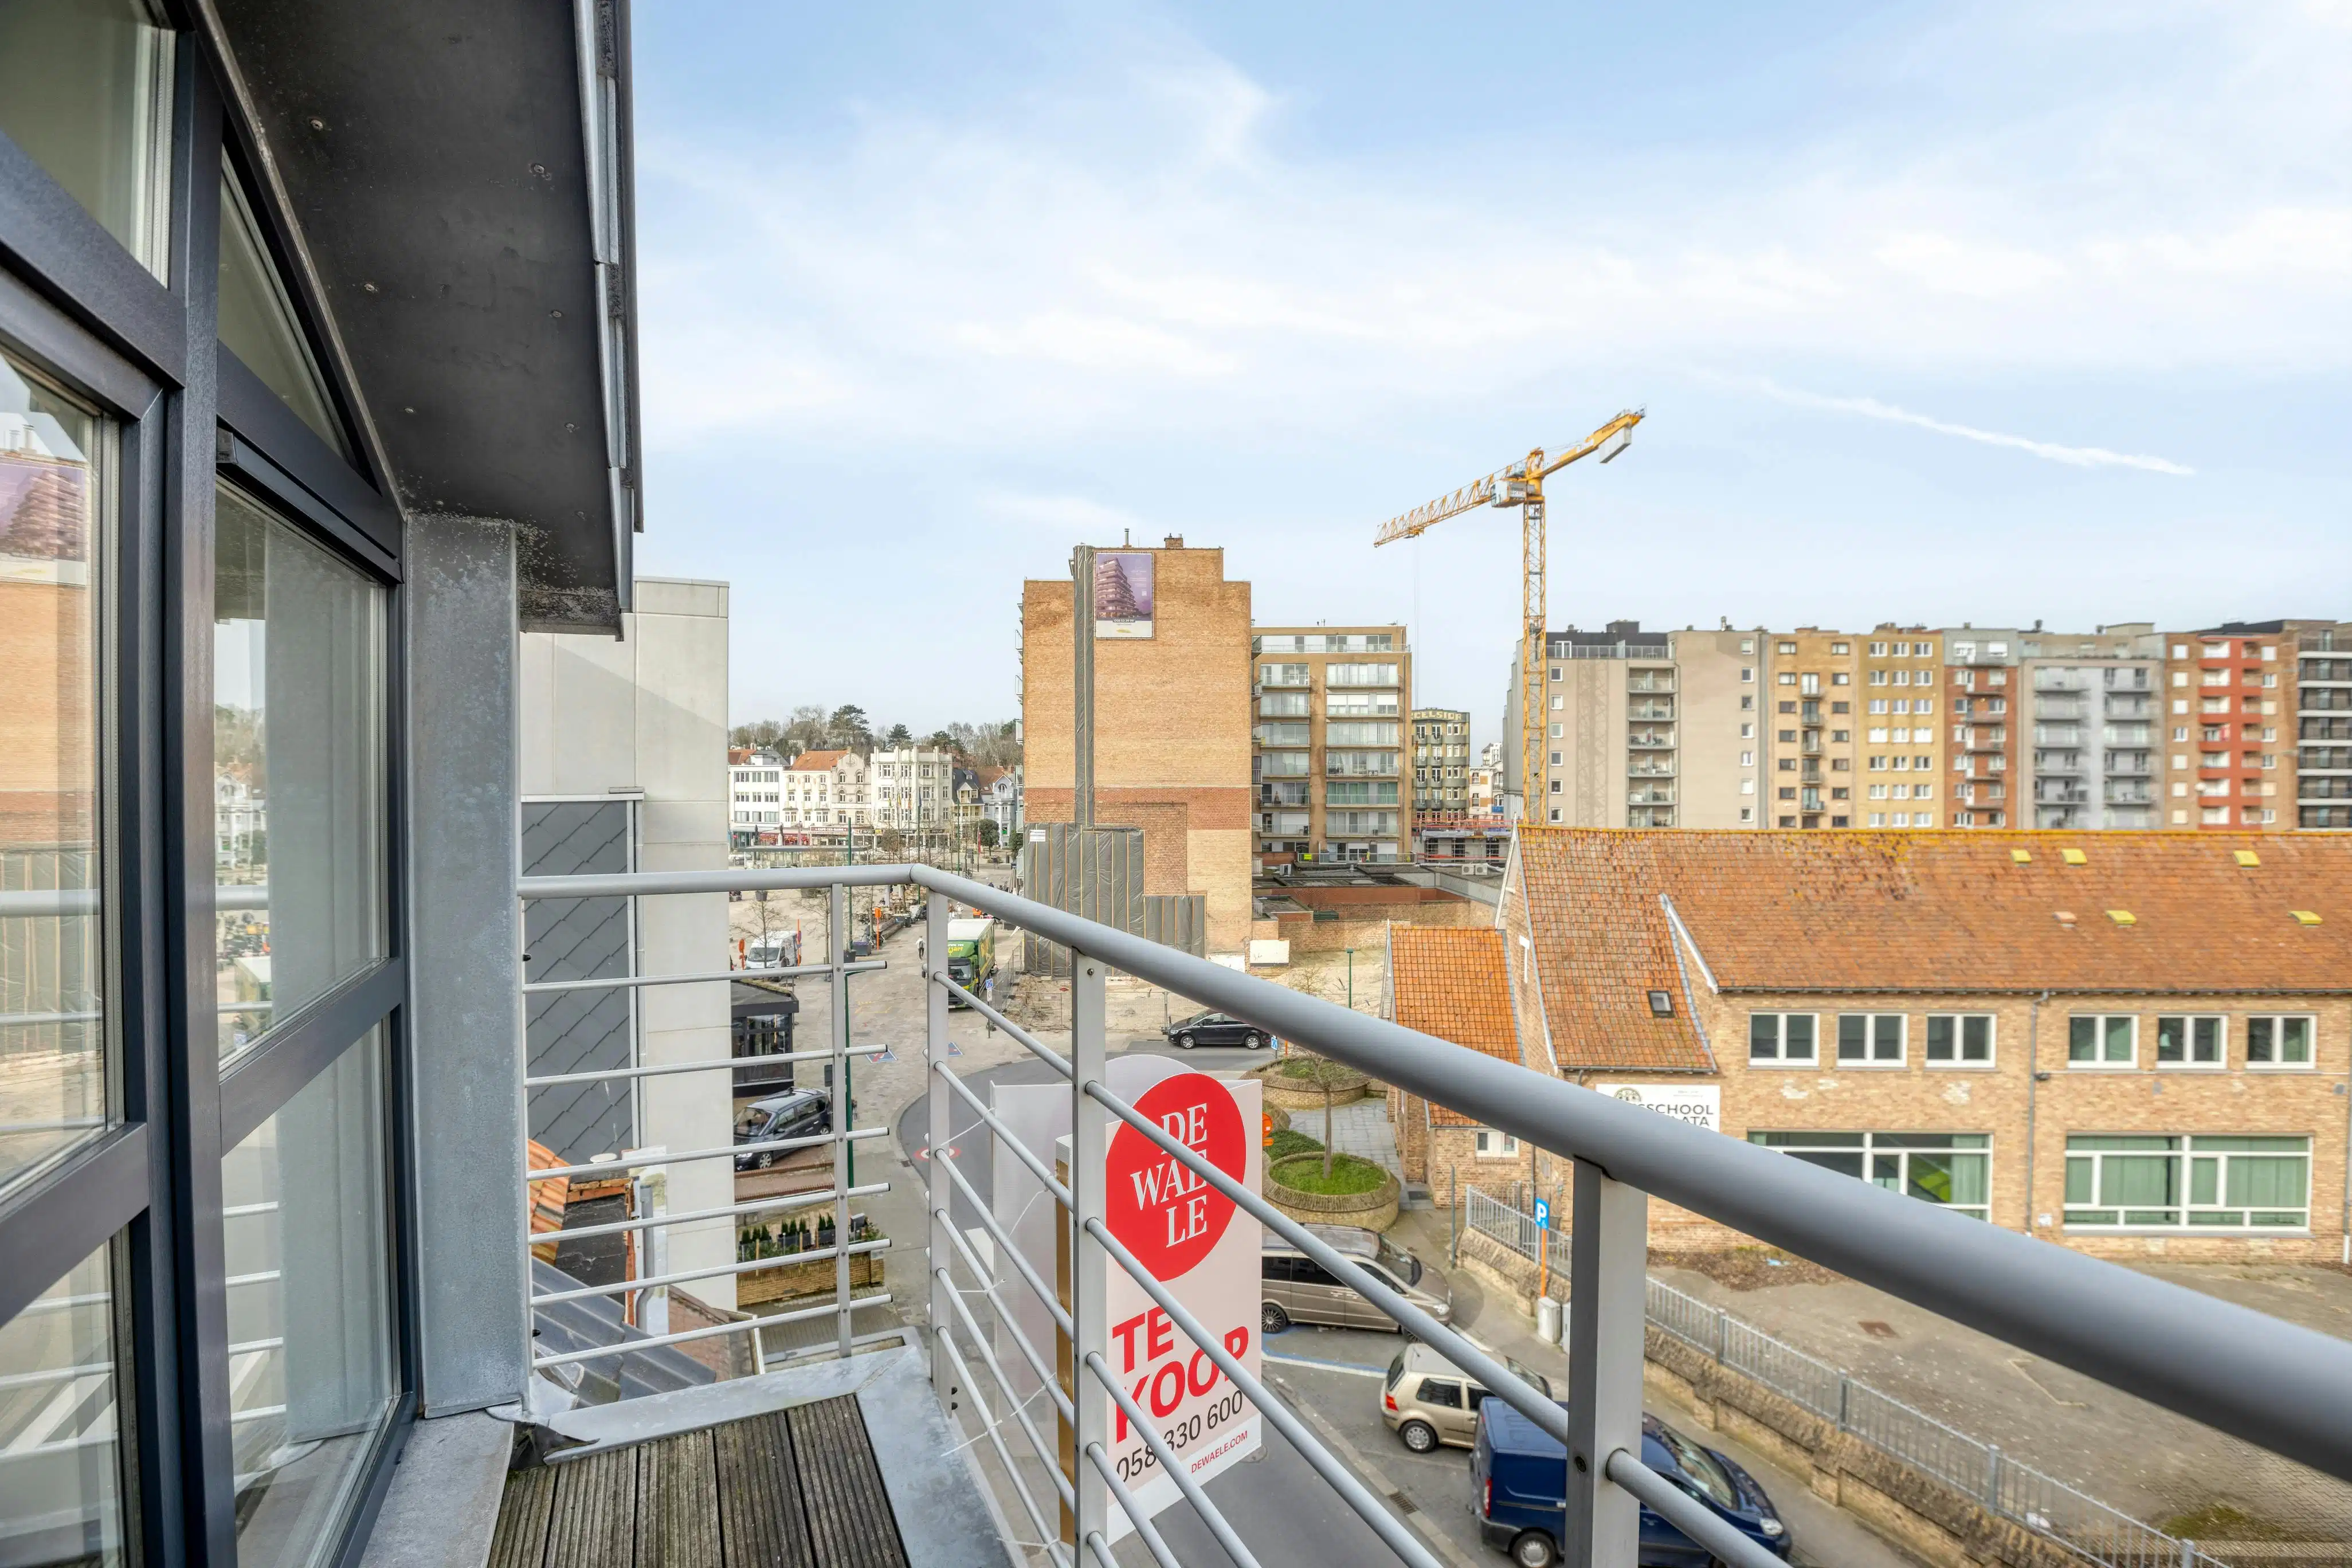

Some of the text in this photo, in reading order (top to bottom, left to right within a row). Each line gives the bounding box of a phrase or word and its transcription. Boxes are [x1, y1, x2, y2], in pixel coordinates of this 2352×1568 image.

[1161, 1103, 1208, 1155] DE
[1166, 1195, 1208, 1248] LE
[1537, 1202, 1547, 1222] P
[1112, 1305, 1174, 1374] TE
[1116, 1390, 1243, 1483] 058 330 600
[1191, 1430, 1248, 1474] DEWAELE.COM
